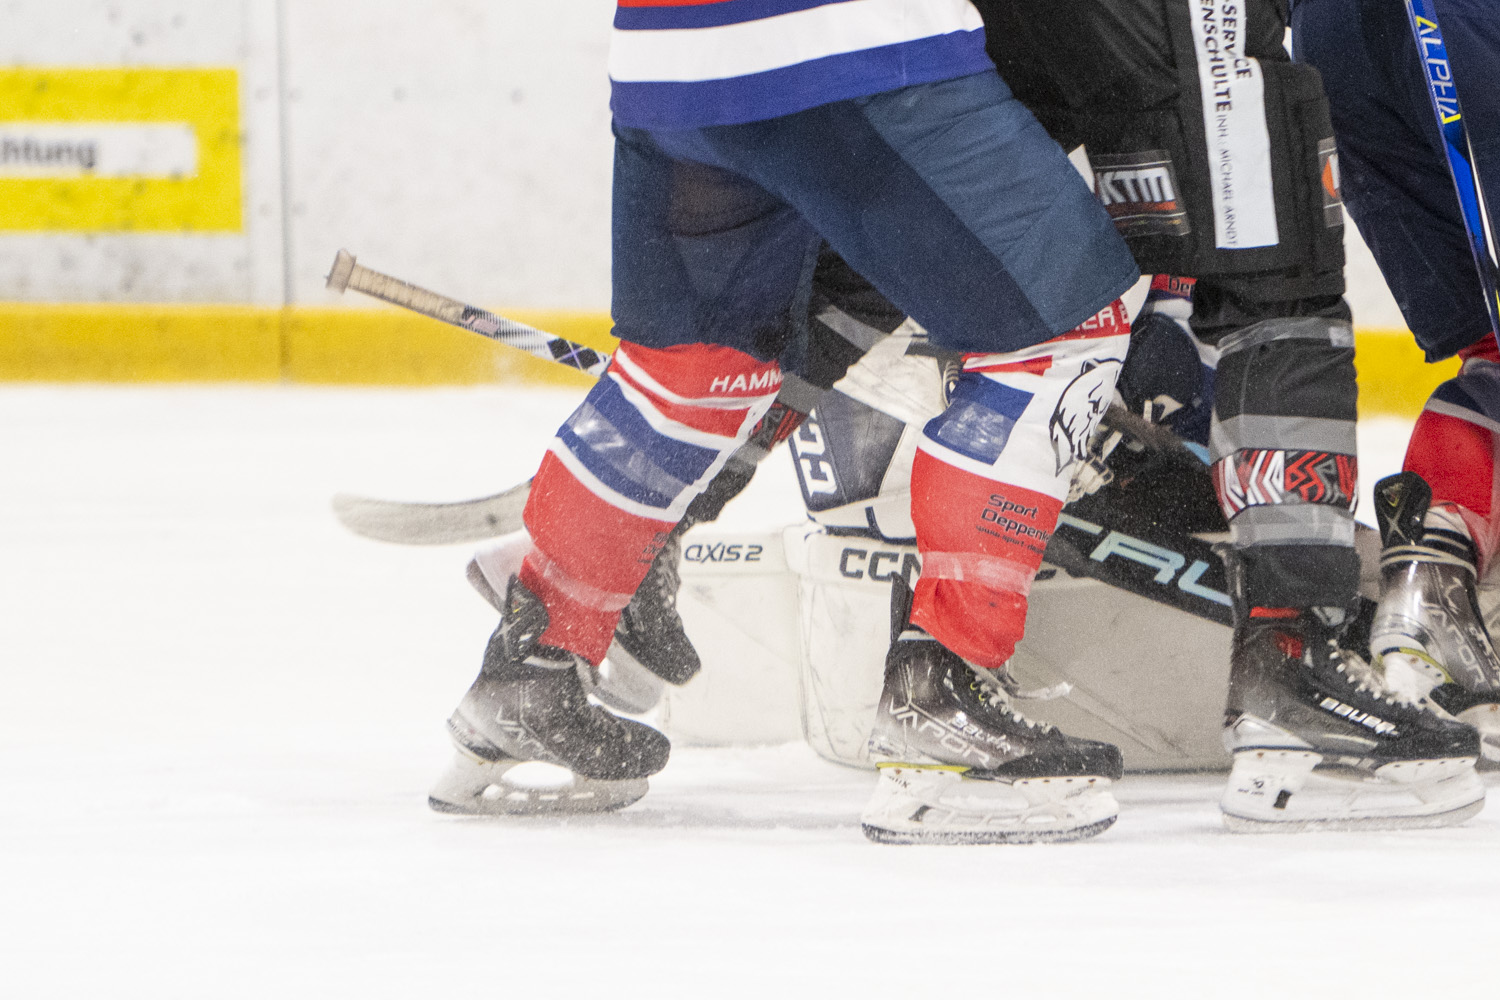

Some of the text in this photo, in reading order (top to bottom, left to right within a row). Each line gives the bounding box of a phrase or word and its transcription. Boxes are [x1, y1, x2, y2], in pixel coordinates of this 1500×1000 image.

[1415, 15, 1462, 124] ALPHA
[709, 368, 784, 393] HAMM
[987, 493, 1038, 519] Sport
[889, 696, 990, 769] VAPOR
